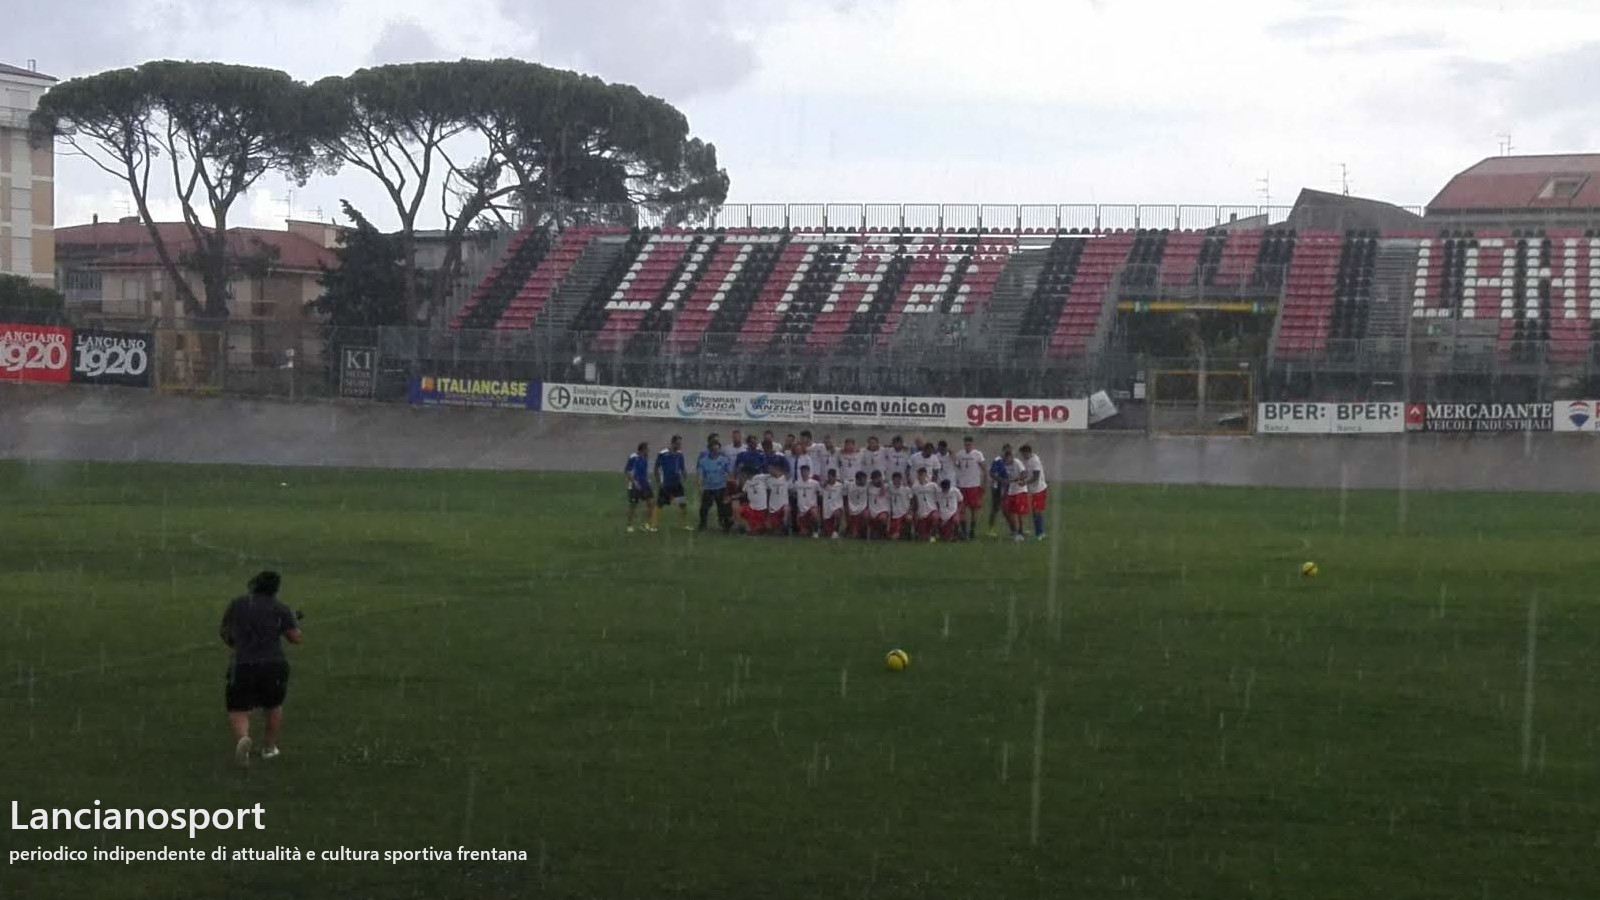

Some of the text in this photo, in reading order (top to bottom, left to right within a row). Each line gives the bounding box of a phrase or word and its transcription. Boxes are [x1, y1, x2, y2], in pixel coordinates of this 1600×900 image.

[78, 335, 146, 350] LANCIANO
[75, 346, 147, 377] 1920
[437, 378, 527, 397] ITALIANCASE
[572, 396, 609, 407] ANZUCA
[634, 400, 671, 410] ANZUCA
[813, 396, 878, 412] unicam
[880, 398, 946, 414] unicam
[967, 400, 1070, 426] galeno
[1426, 403, 1552, 419] MERCADANTE
[1426, 418, 1472, 430] VEICOLI
[1477, 418, 1552, 430] INDUSTRIALI
